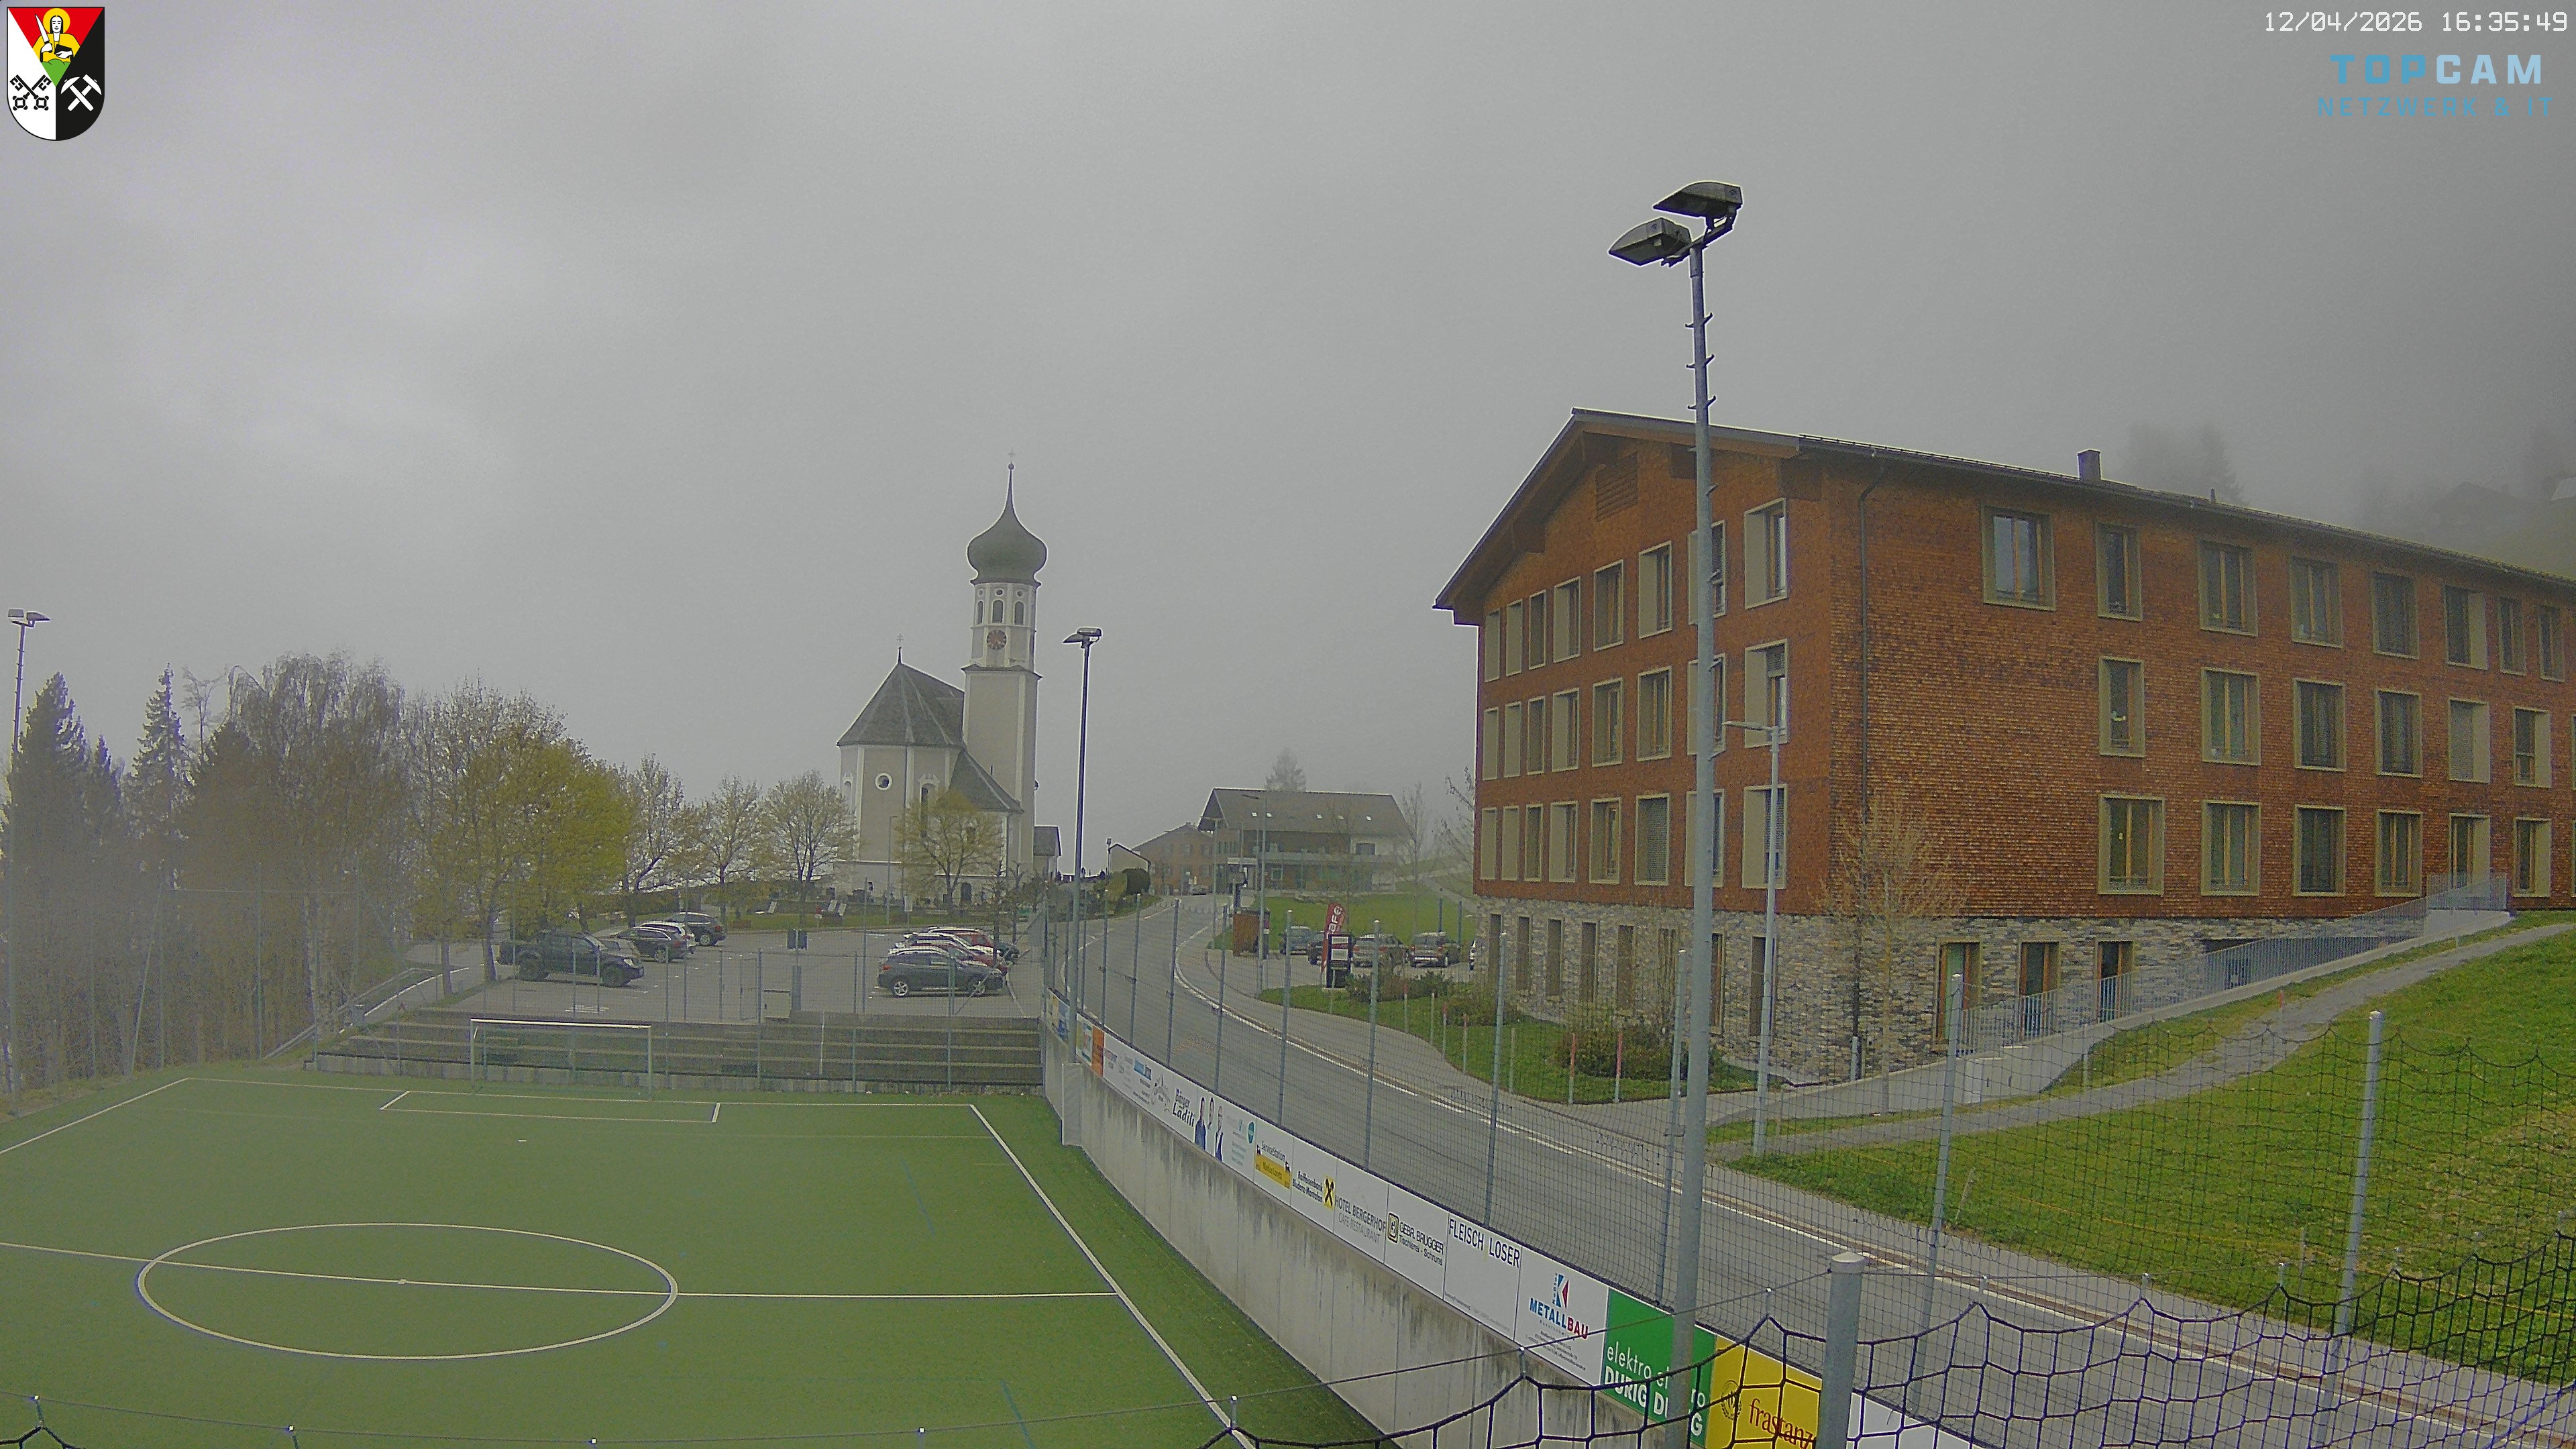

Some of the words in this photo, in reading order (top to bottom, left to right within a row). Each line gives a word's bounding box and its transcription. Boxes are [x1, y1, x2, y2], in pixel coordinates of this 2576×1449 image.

[1335, 1195, 1351, 1214] HOTEL
[1352, 1205, 1386, 1232] BERGERHOF
[1399, 1222, 1415, 1240] GEBR.
[1416, 1230, 1444, 1255] BRUGGER
[1424, 1248, 1443, 1266] Schruns
[1449, 1218, 1484, 1251] FLEISCH
[1489, 1237, 1520, 1268] LOSER
[1529, 1297, 1589, 1340] METALLBAU
[1607, 1341, 1652, 1379] elektro
